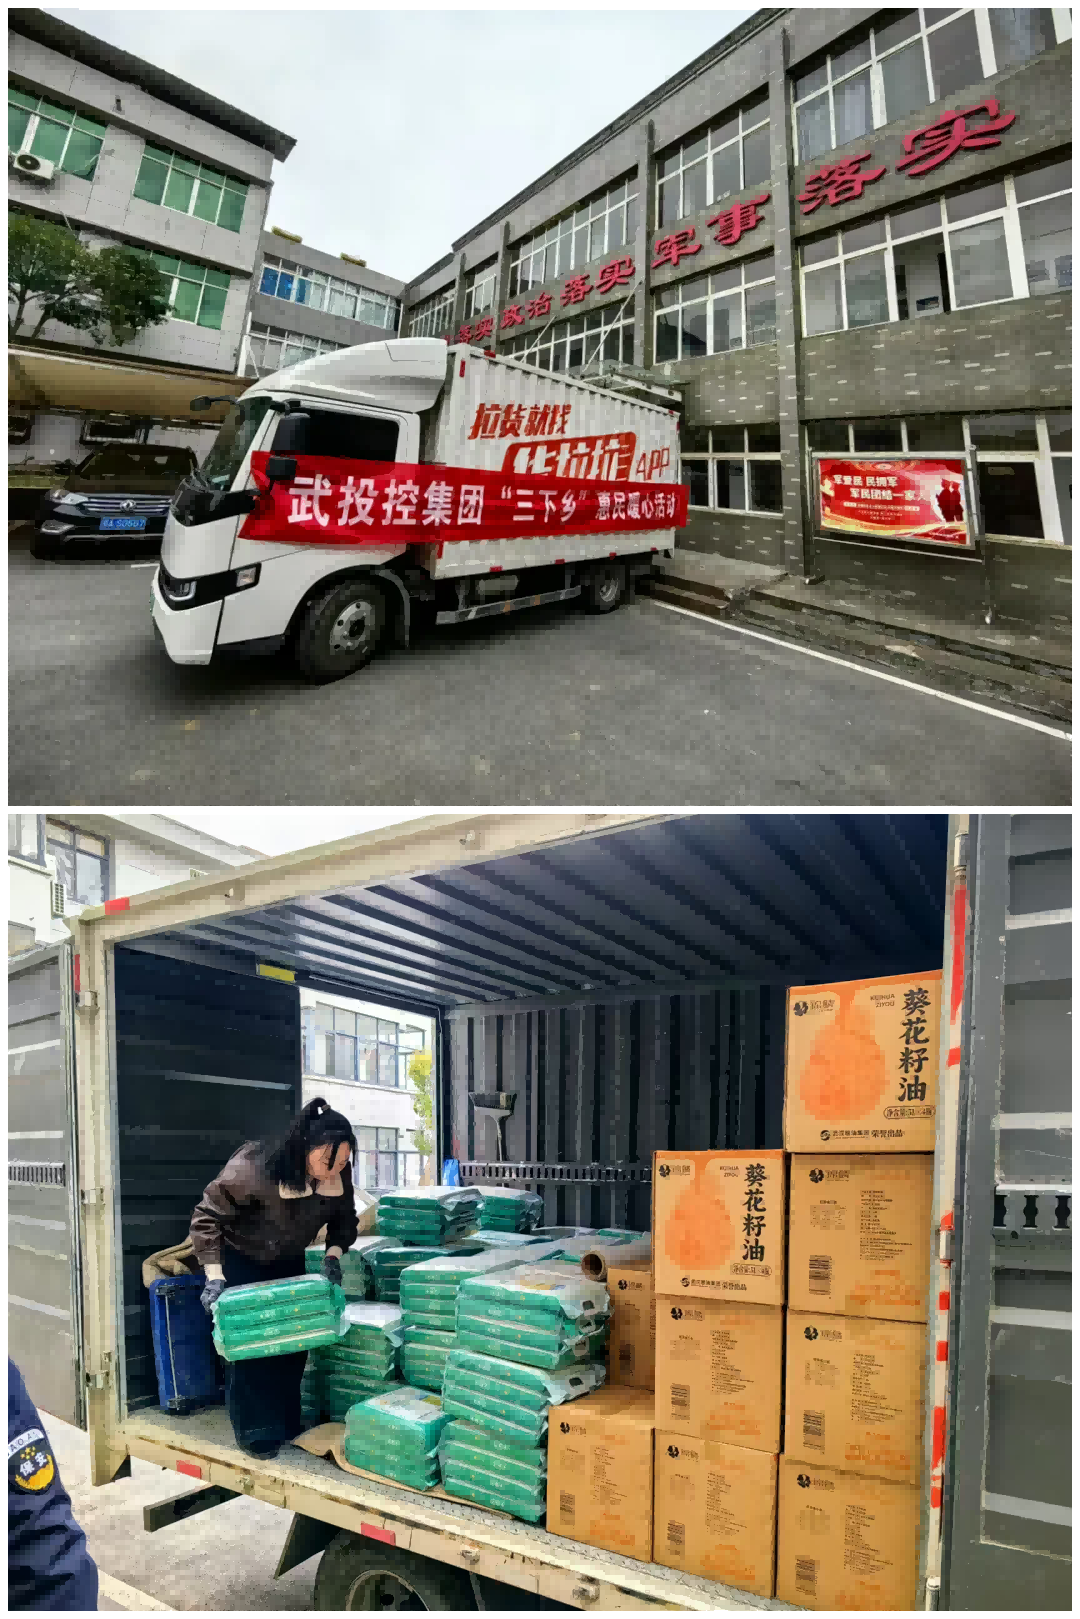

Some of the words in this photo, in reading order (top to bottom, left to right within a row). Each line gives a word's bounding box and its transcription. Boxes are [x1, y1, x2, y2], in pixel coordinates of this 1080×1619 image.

[797, 98, 1016, 216] 落实
[467, 403, 572, 440] 拉货就找
[287, 474, 486, 528] 武投控集团
[595, 491, 676, 520] 惠民暖心活动
[636, 447, 670, 482] APP
[897, 987, 931, 1102] 葵花籽油
[742, 1163, 767, 1262] 葵花籽油
